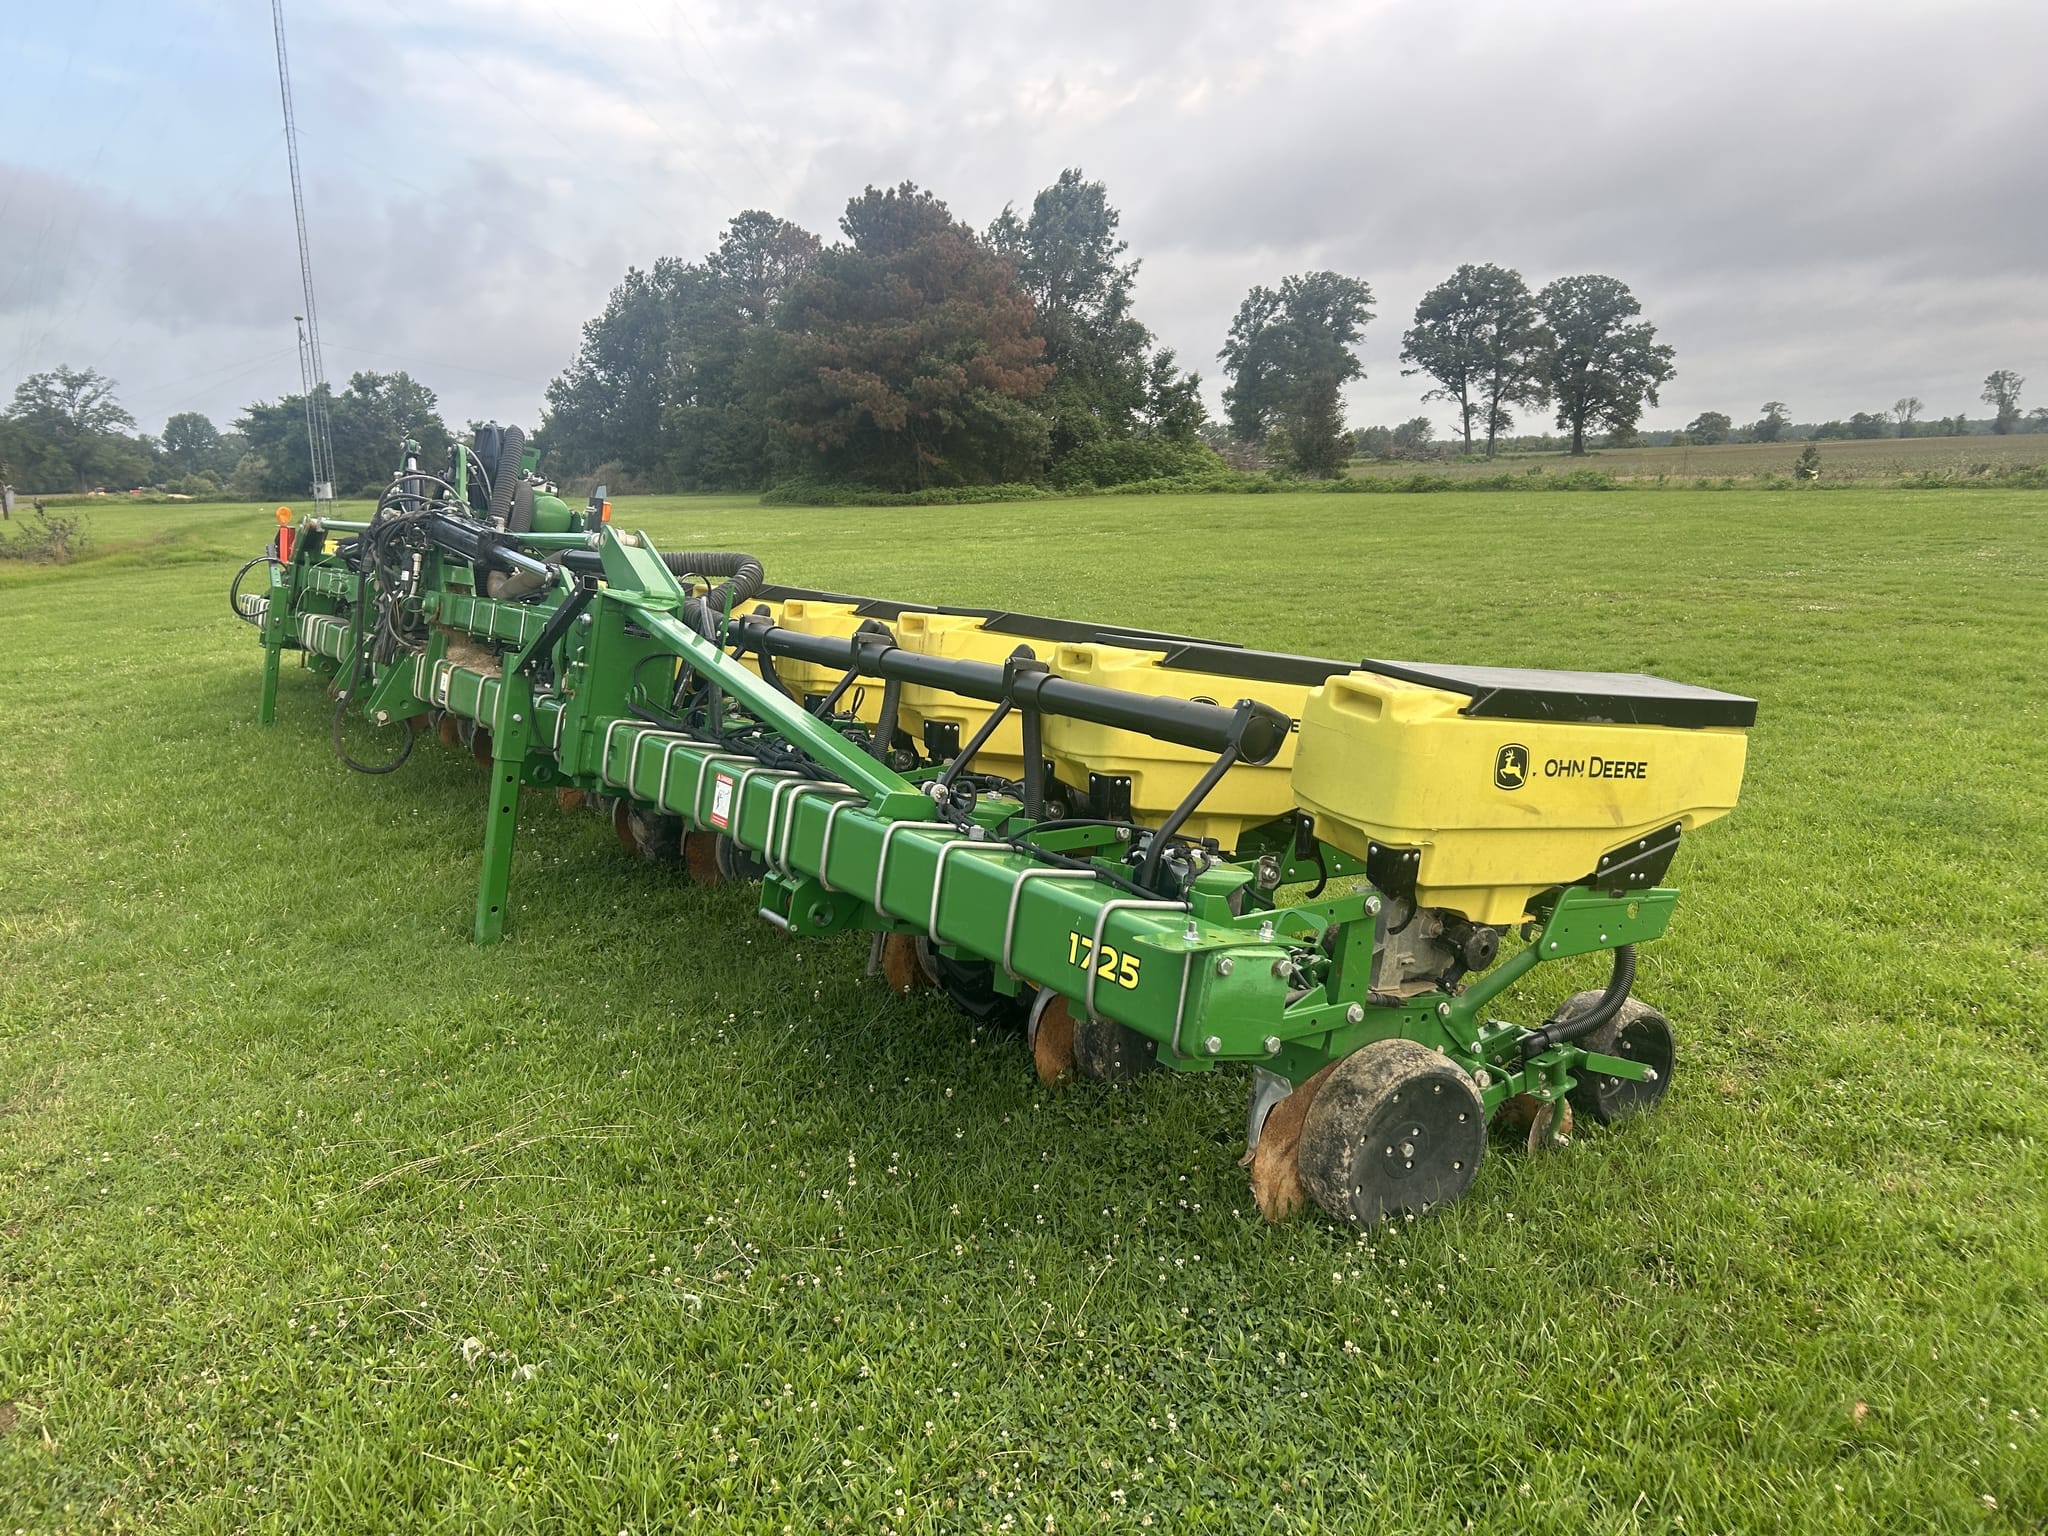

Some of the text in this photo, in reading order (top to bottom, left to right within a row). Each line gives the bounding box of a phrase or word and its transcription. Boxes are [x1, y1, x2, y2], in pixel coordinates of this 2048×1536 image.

[1532, 756, 1648, 779] OHN DEERE
[1067, 930, 1141, 990] 1725
